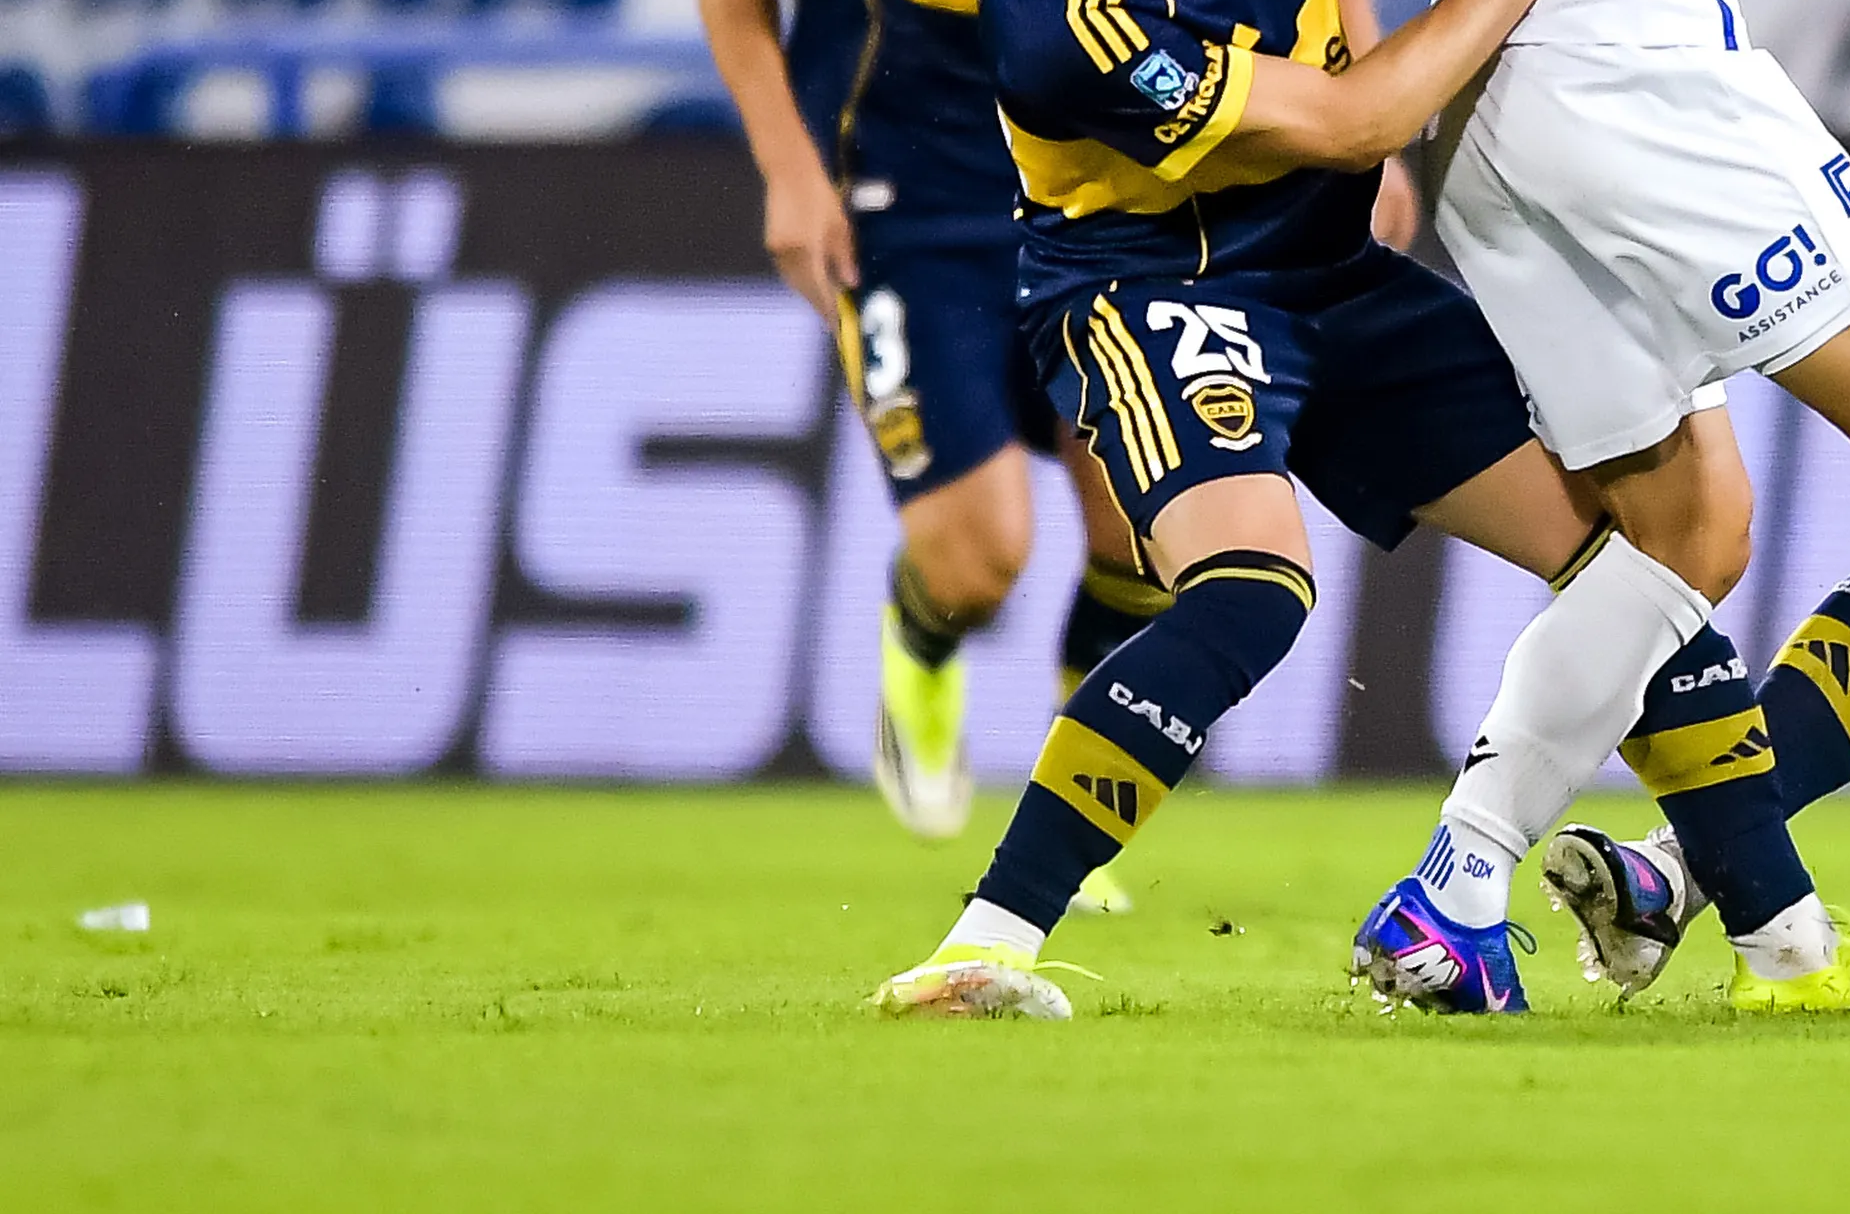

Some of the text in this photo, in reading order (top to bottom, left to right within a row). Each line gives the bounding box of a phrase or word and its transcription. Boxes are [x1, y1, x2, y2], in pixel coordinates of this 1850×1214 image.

[1711, 224, 1827, 320] GO!
[1738, 270, 1842, 343] ASSISTANCE
[861, 287, 910, 399] 3
[1146, 300, 1272, 384] 25
[1670, 657, 1749, 693] CAB
[1108, 682, 1203, 755] CABJ
[1462, 852, 1495, 879] SOX
